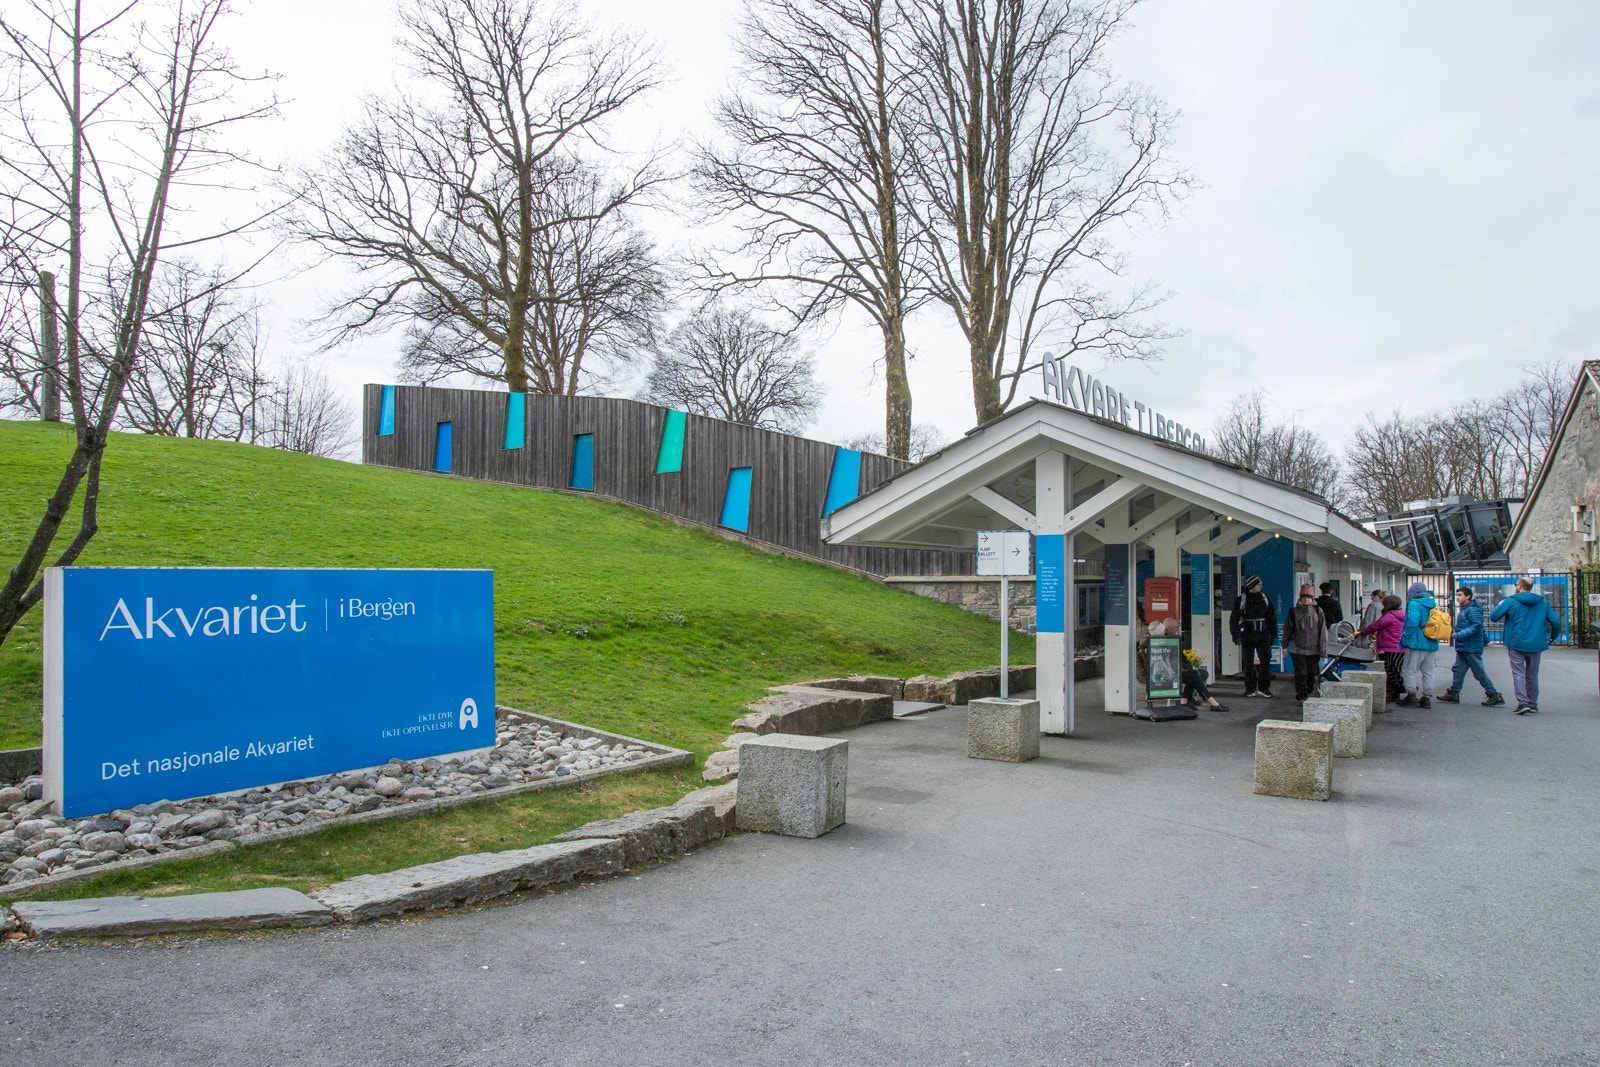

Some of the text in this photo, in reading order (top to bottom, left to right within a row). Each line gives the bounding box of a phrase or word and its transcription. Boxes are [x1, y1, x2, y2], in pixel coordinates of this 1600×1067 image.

[1042, 351, 1146, 433] AKVARIET
[99, 593, 416, 641] Akvariet i Bergen
[382, 721, 453, 738] EKTE OPPLEVELSER
[418, 711, 453, 723] EKTE DYR
[101, 734, 314, 780] Det nasjonale Akvariet
